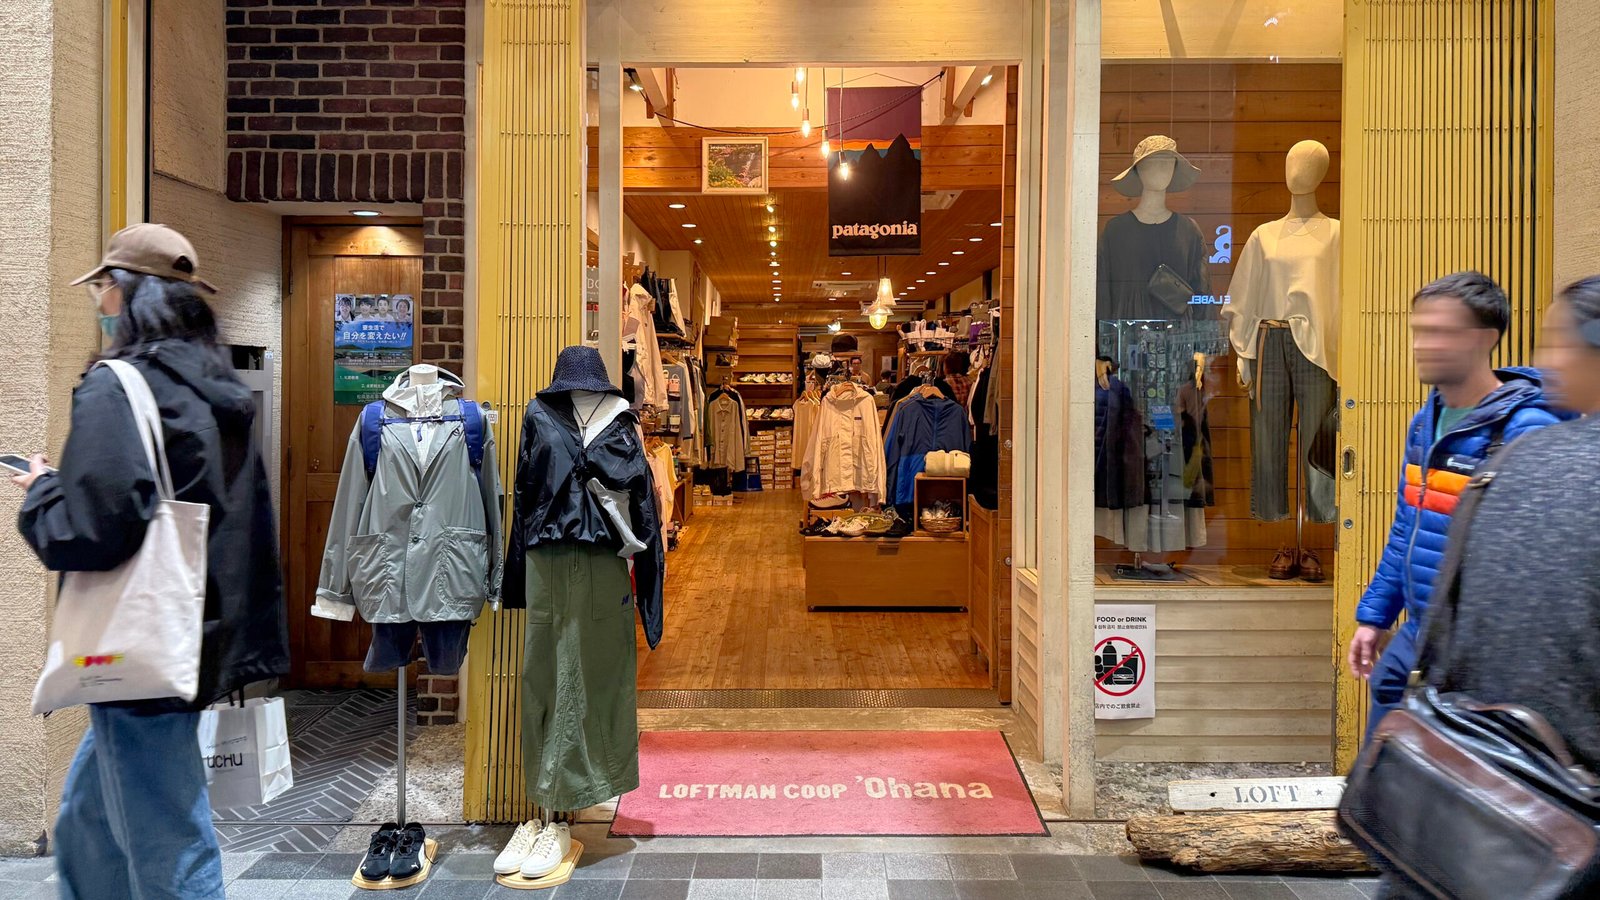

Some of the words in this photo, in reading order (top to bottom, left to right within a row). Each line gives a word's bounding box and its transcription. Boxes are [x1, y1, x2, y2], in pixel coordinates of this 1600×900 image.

[832, 220, 918, 239] patagonia
[207, 752, 243, 769] UCHU
[659, 783, 776, 799] LOFTMAN
[783, 783, 848, 799] COOP
[855, 775, 994, 799] 'Ohana
[1233, 785, 1299, 803] LOFT
